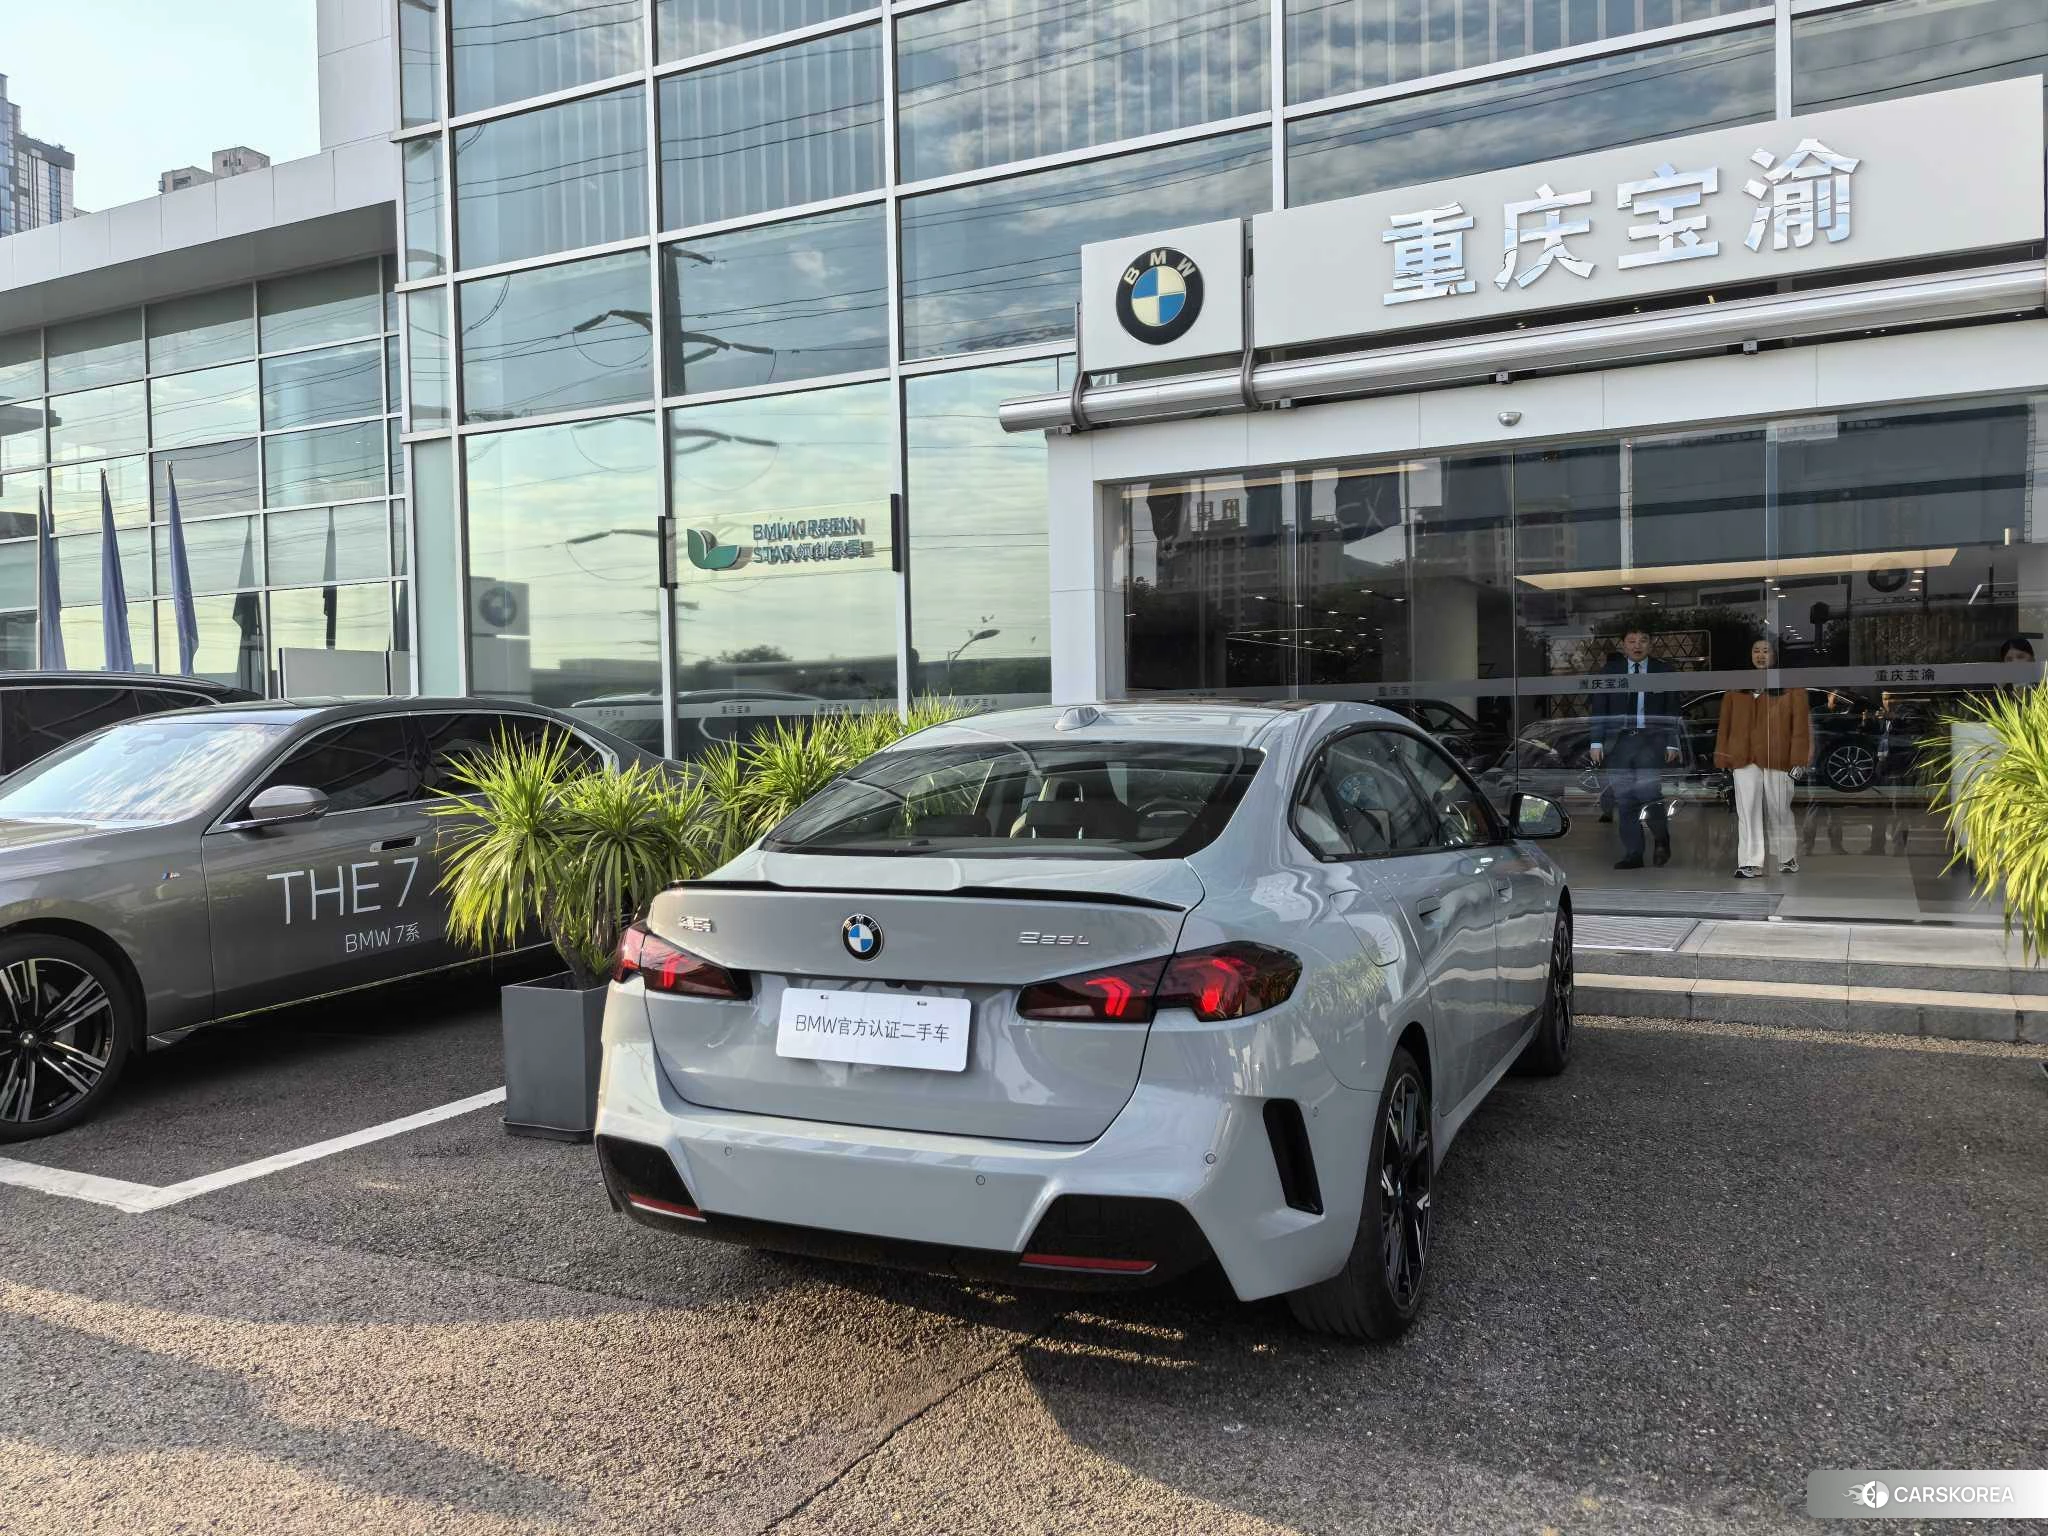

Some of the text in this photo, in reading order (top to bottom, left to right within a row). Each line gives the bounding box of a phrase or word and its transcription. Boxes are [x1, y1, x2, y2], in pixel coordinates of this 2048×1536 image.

[1382, 138, 1861, 306] 重庆宝渝
[1123, 250, 1196, 286] BMW
[266, 856, 419, 924] THE 7
[345, 922, 420, 952] BMW 7系
